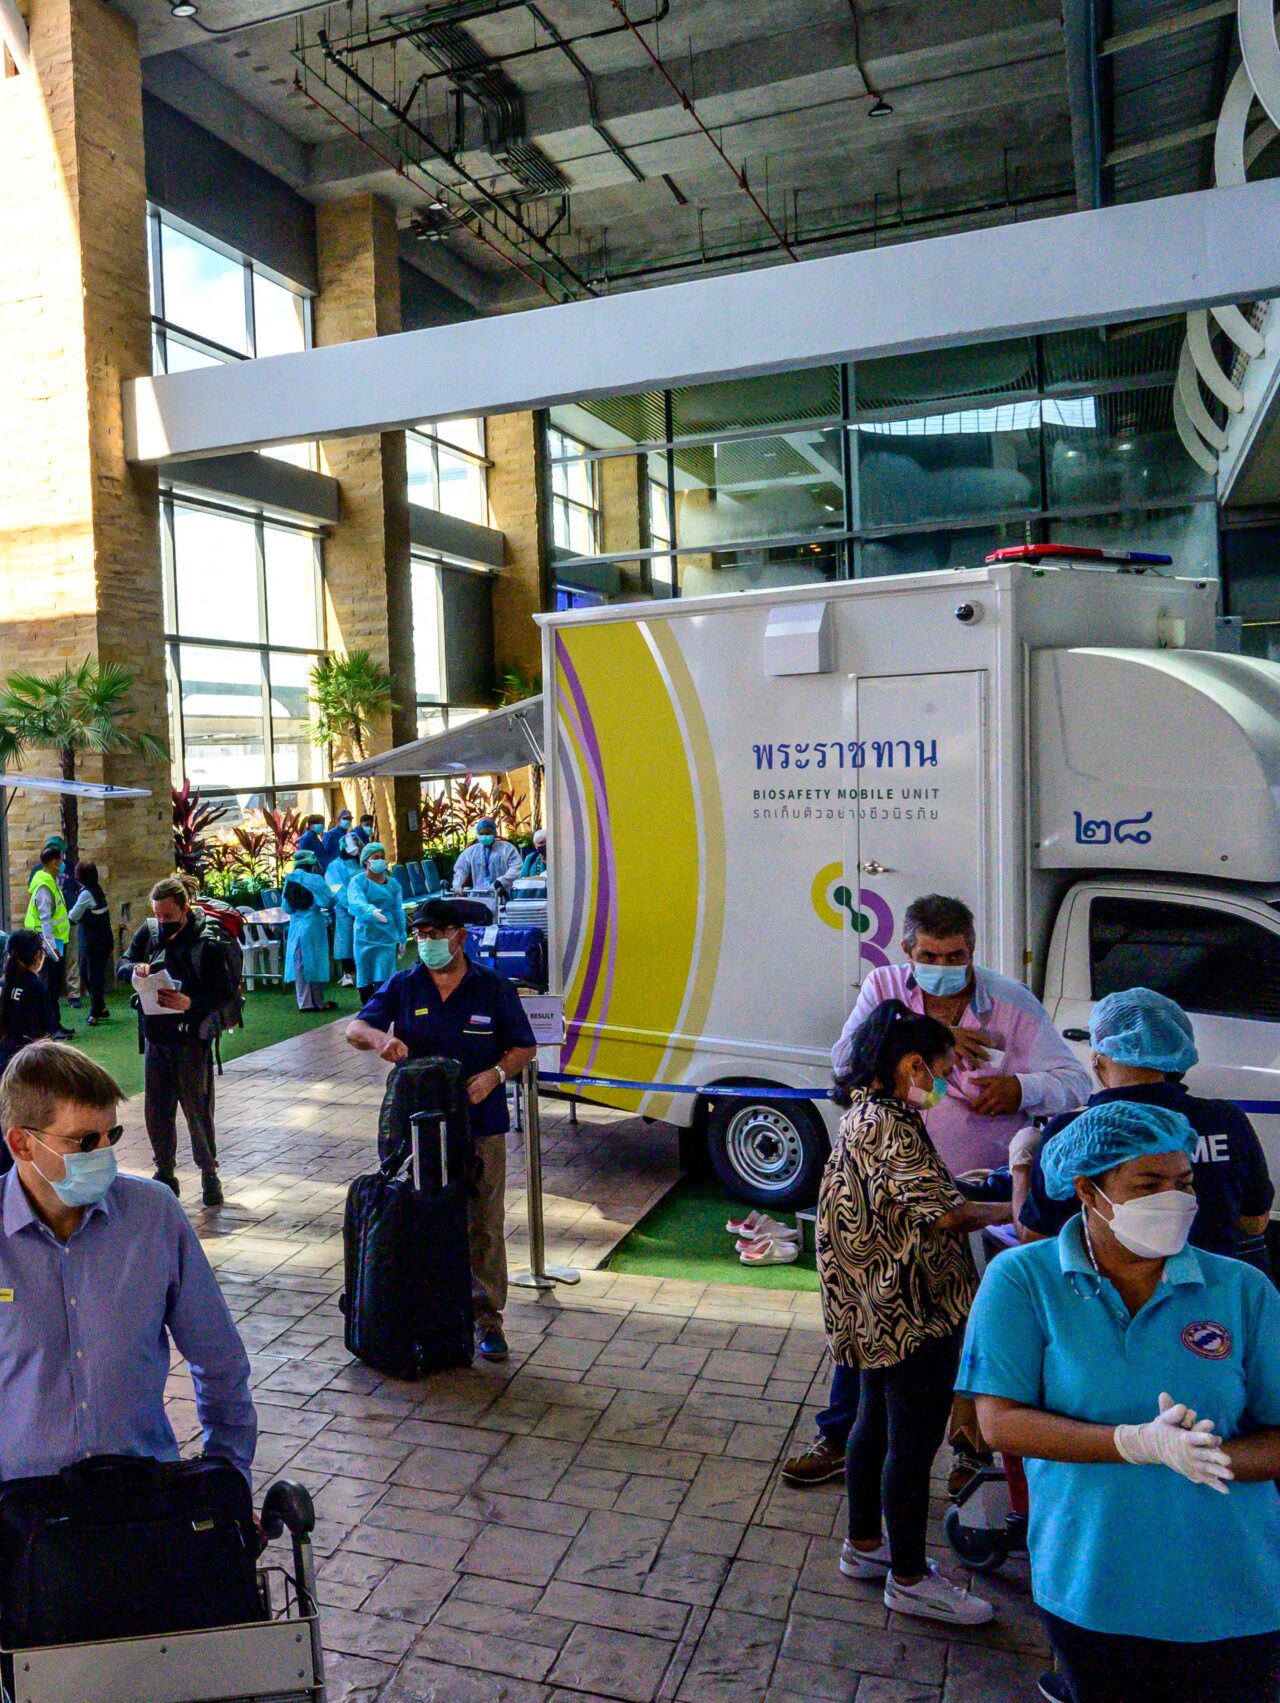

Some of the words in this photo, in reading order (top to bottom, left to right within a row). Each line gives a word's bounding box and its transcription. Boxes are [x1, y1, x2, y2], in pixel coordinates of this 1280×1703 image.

[753, 739, 938, 770] พระราชทาน
[753, 789, 831, 800] BIOSAFETY
[838, 788, 893, 800] MOBILE
[901, 788, 939, 800] UNIT
[1073, 811, 1153, 845] ๒๘
